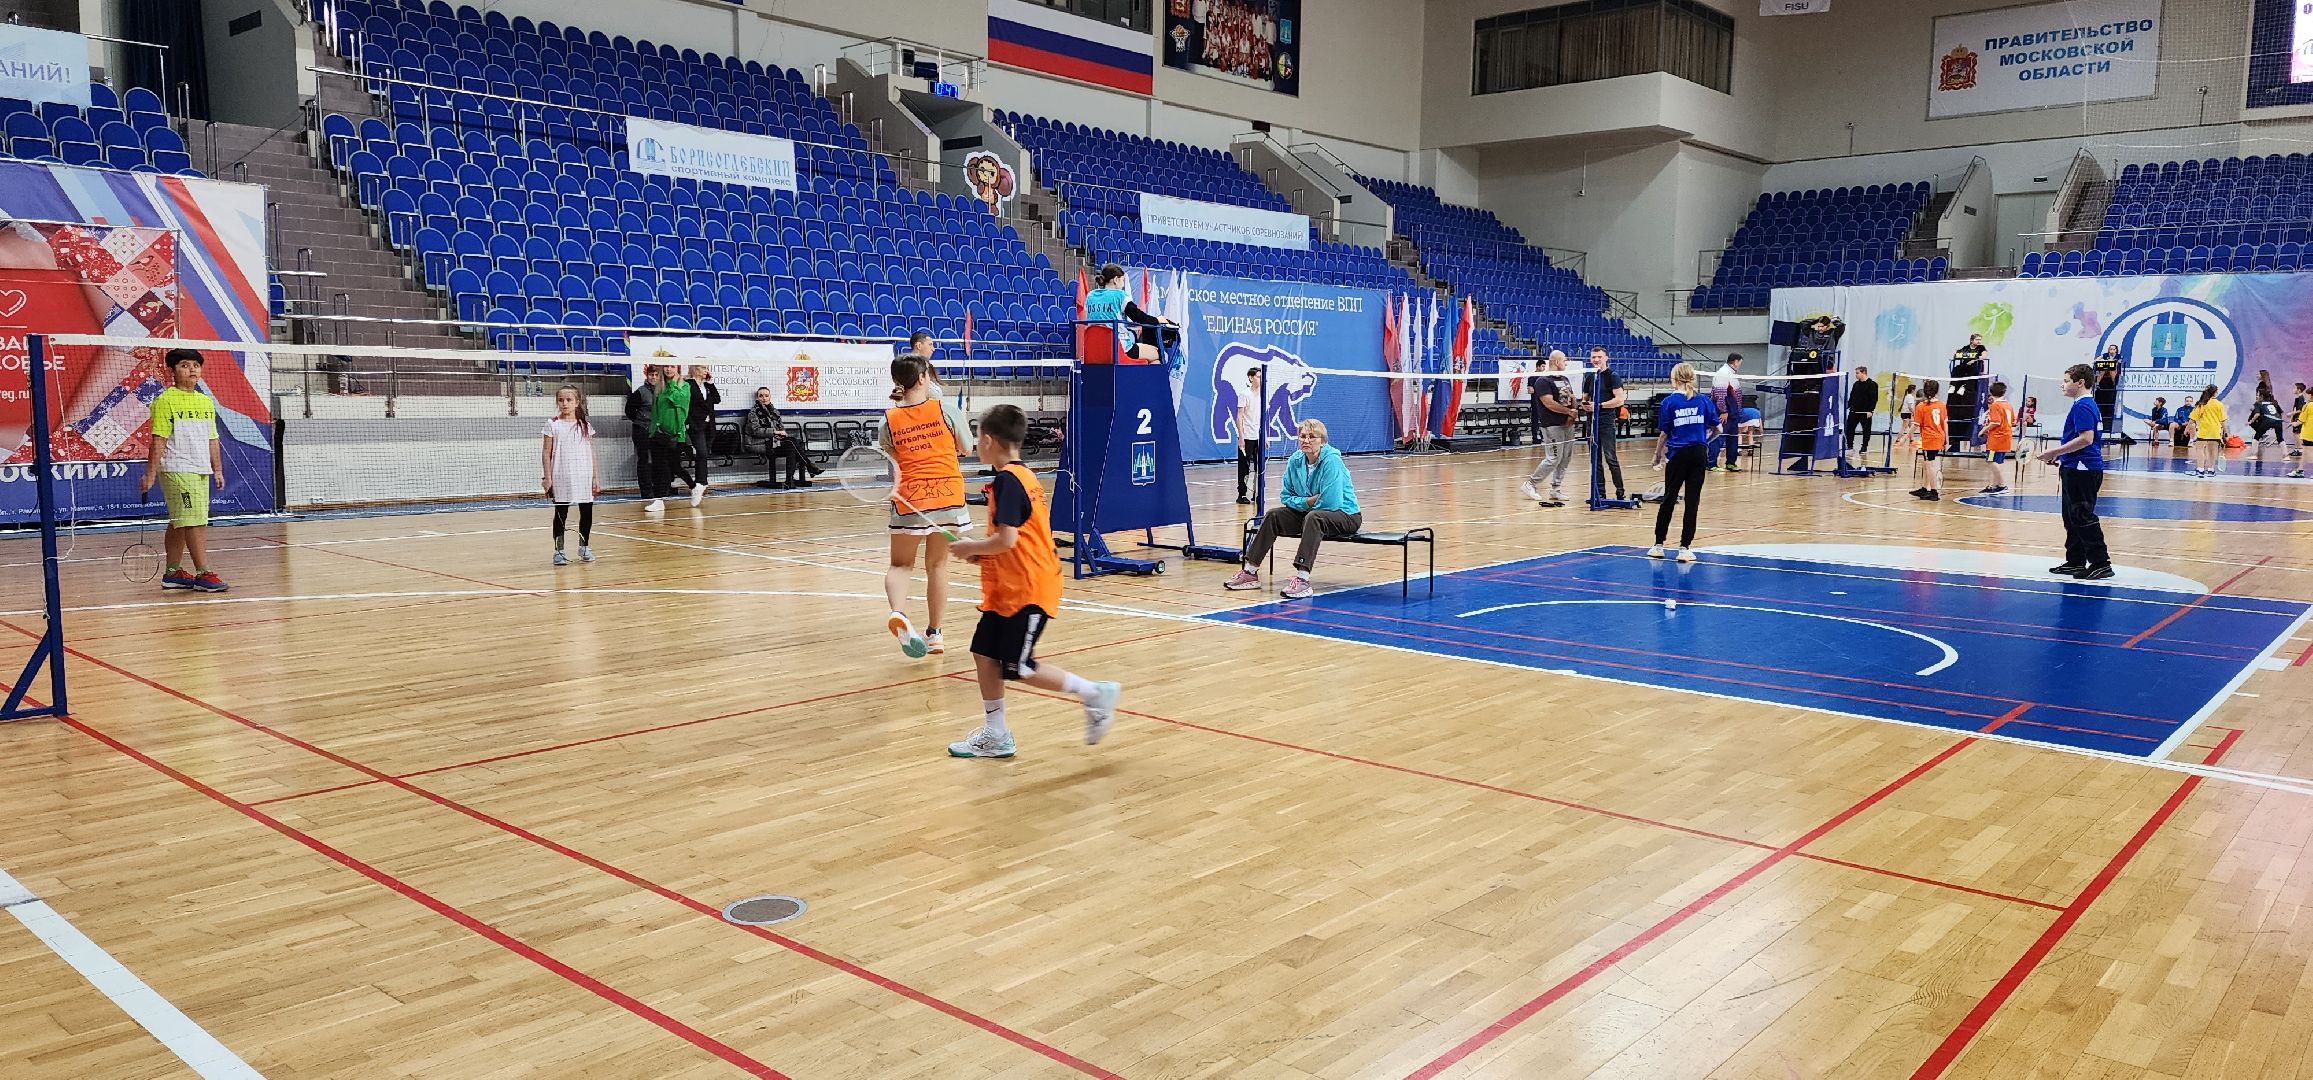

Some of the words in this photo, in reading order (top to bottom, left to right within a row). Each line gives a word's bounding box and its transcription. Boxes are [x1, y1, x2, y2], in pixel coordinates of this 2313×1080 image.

[1784, 1, 1809, 11] FISU
[1984, 19, 2154, 51] ПРАВИТЕЛЬСТВО
[2000, 36, 2134, 66] МОСКОВСКОЙ
[2018, 60, 2111, 81] ОБЛАСТИ
[669, 145, 791, 177] БОРИСОГЛЕБСКИЙ
[671, 166, 740, 181] спортивный
[743, 175, 792, 187] комплекс
[1147, 214, 1204, 231] ПРИВЕТСТВУЕМ
[1205, 221, 1250, 236] УЧАСТНИКОВ
[1219, 290, 1271, 308] местное
[1274, 294, 1335, 312] отделение
[1337, 296, 1364, 313] ВПП
[824, 376, 878, 386] МОСКОВСКОЙ
[1828, 395, 1833, 409] 1
[892, 420, 941, 437] РОССИЙСКИЙ
[1136, 408, 1152, 435] 2
[909, 442, 933, 453] СОЮЗ
